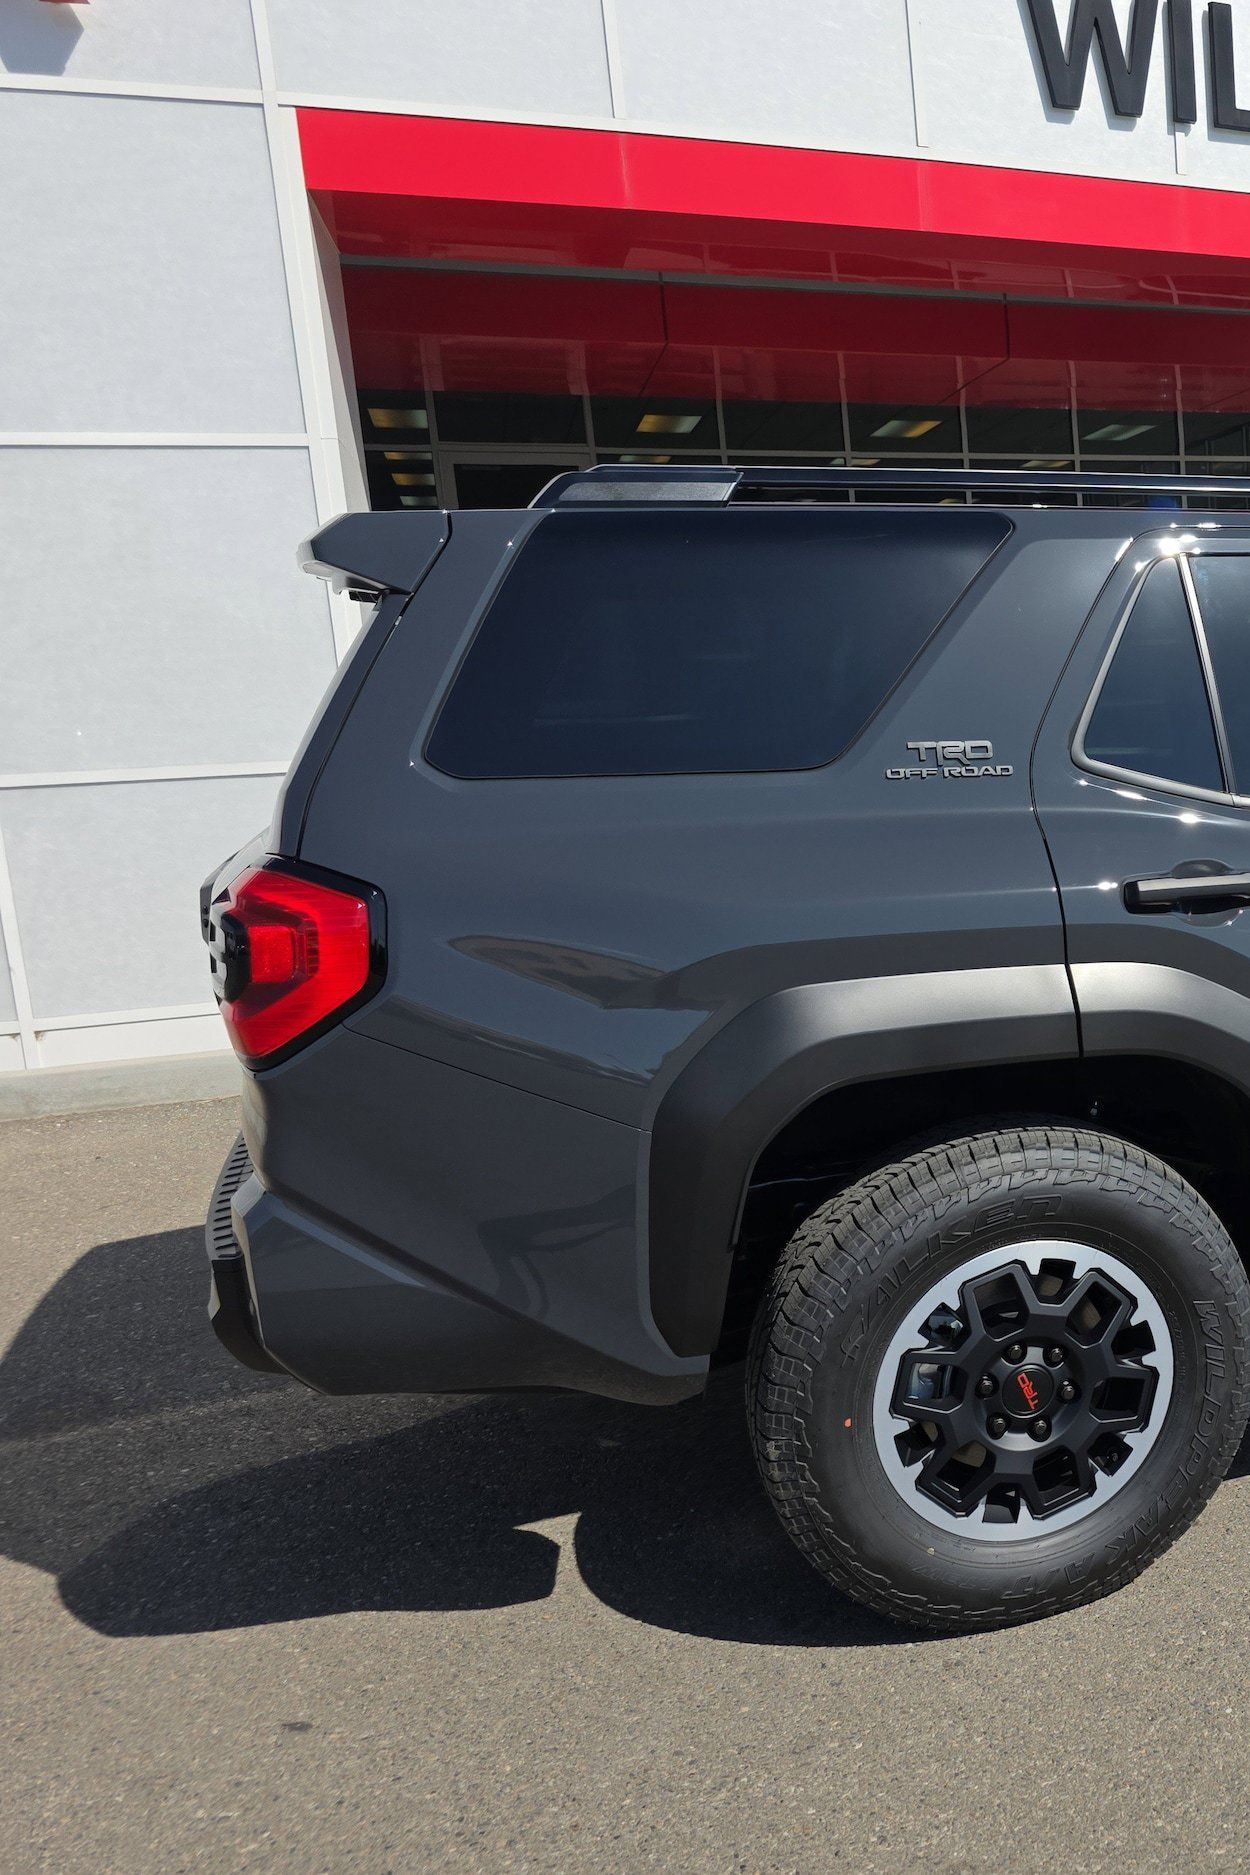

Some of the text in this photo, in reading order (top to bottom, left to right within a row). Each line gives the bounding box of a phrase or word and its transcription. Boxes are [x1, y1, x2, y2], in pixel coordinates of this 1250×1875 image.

[906, 739, 994, 766] TRD
[886, 765, 1014, 779] OFF ROAD
[1017, 1372, 1040, 1410] TRD
[1104, 1300, 1226, 1566] WILDPEAK
